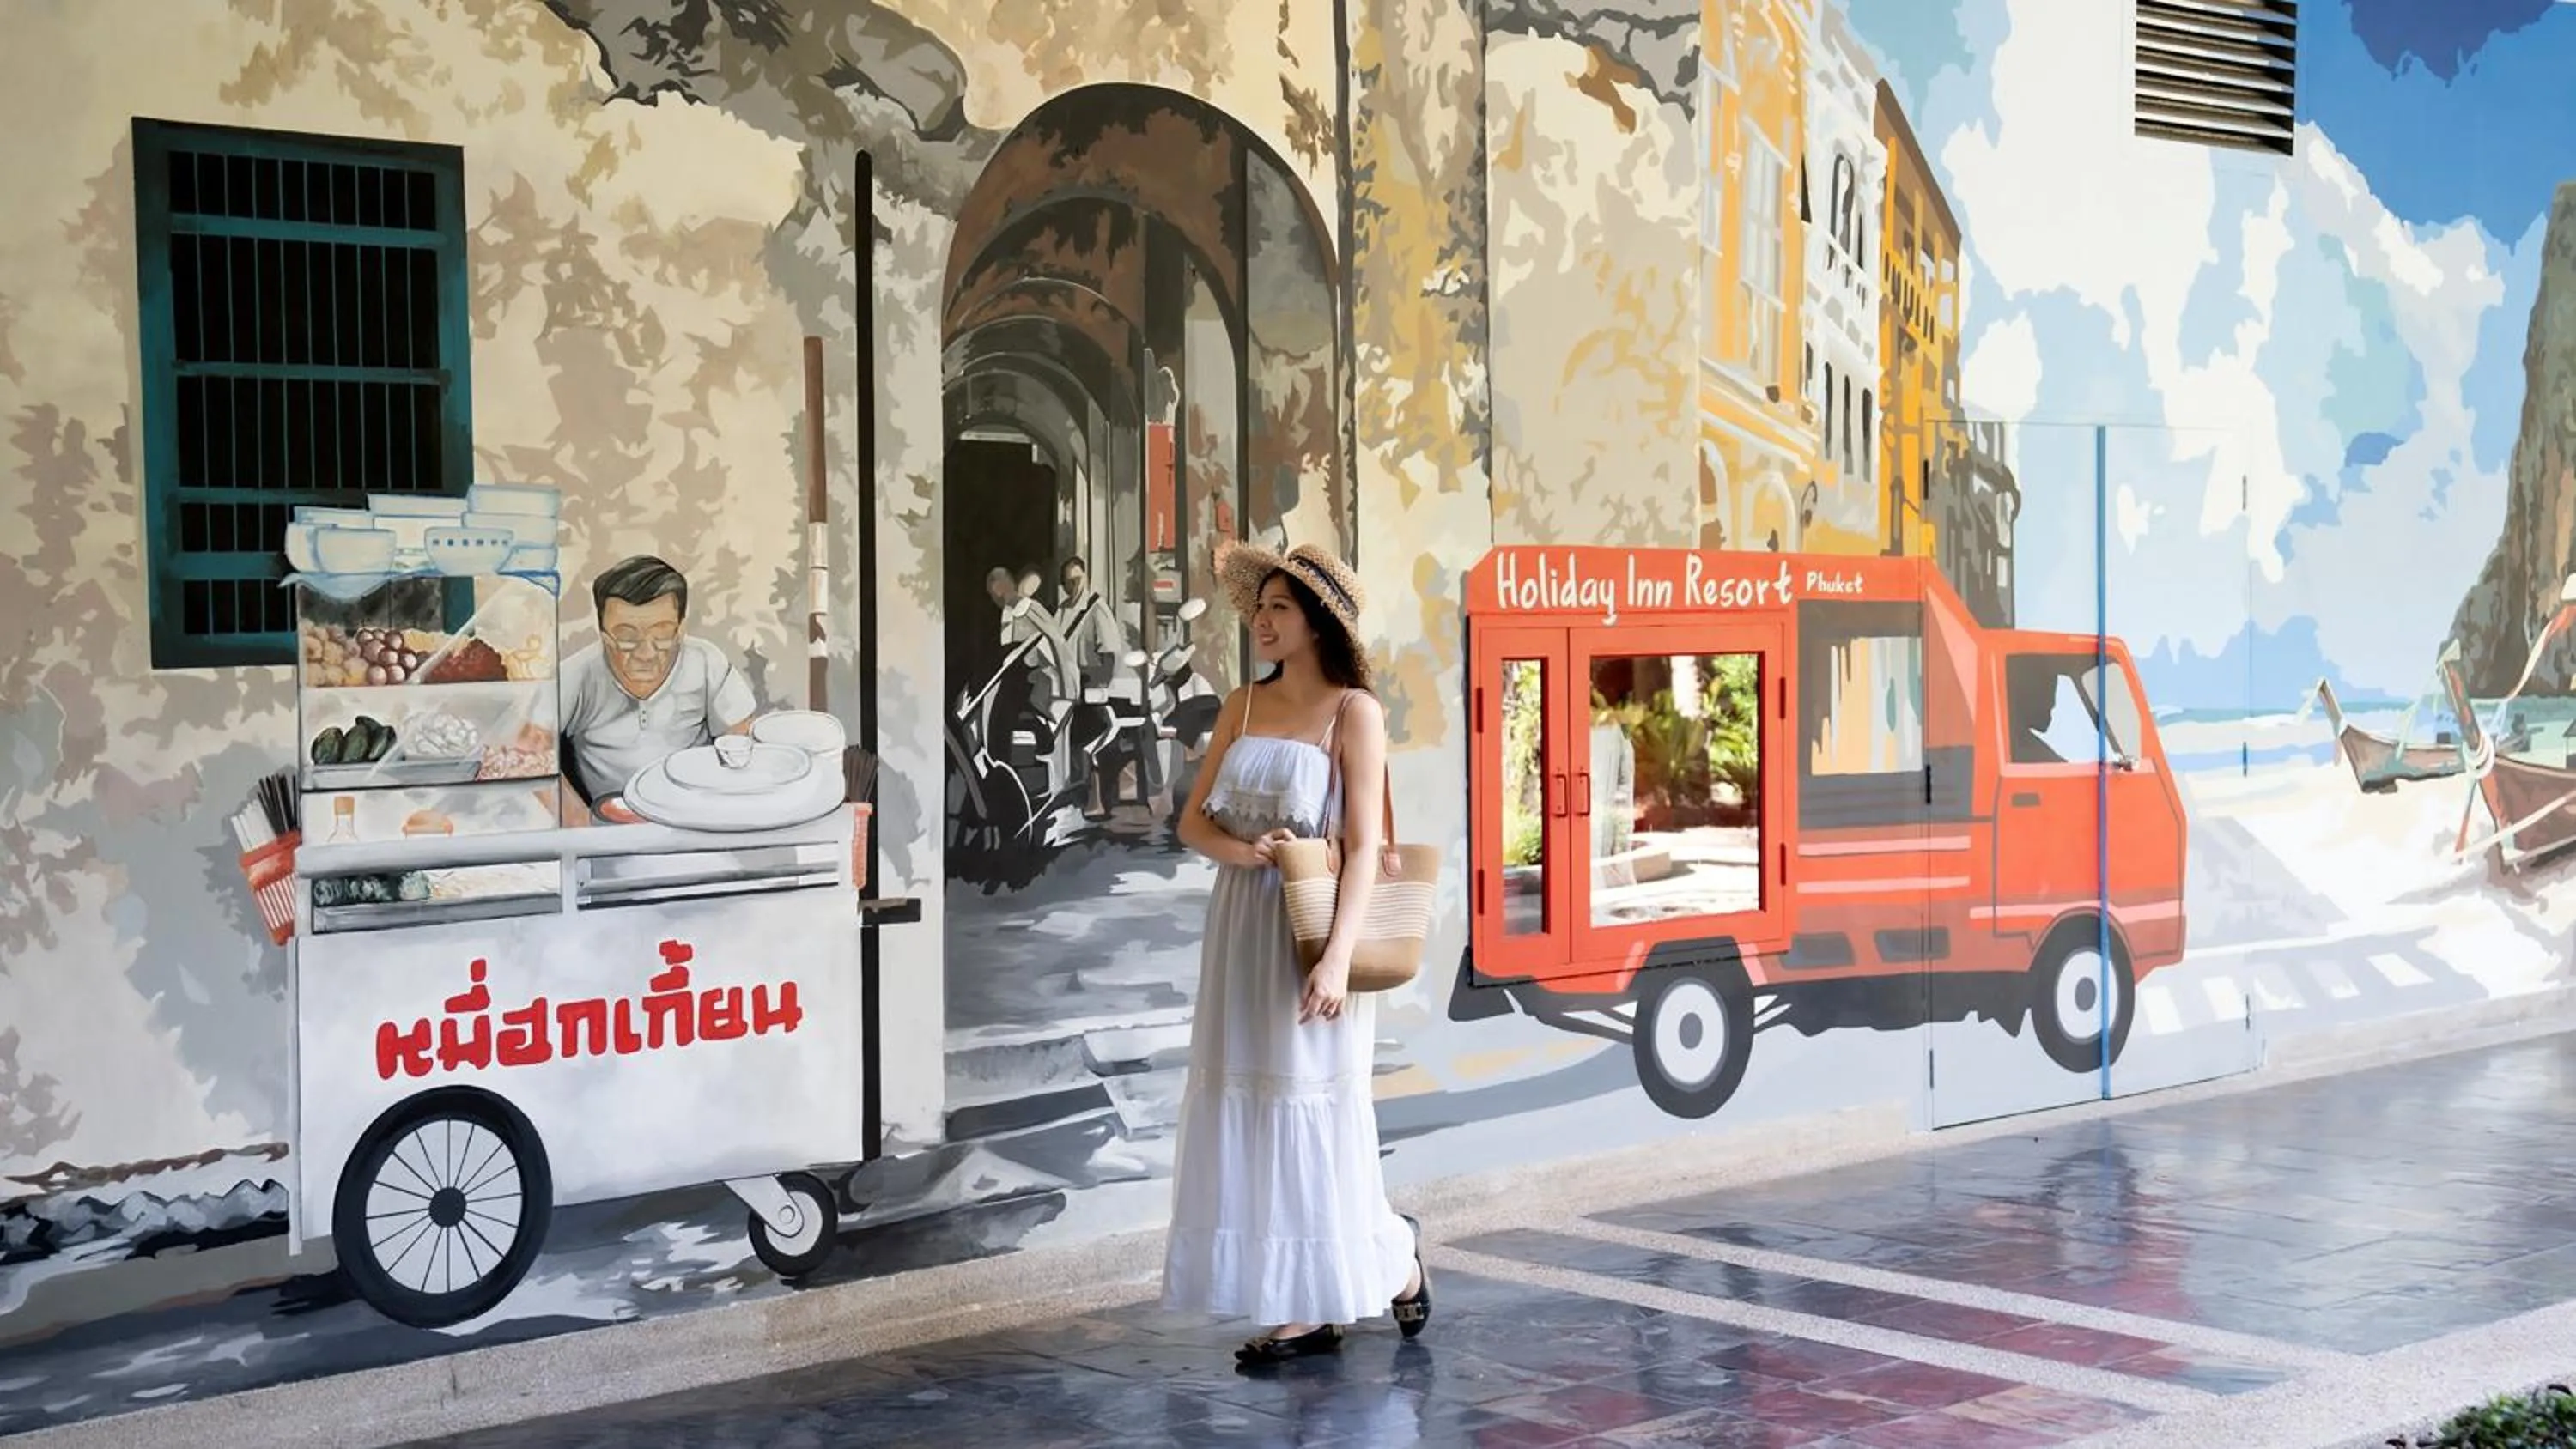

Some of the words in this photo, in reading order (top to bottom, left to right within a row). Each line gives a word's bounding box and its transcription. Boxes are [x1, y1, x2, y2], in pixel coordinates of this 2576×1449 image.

[1496, 551, 1617, 626] Holiday
[1627, 554, 1673, 607] Inn
[1684, 552, 1793, 608] Resort
[1806, 570, 1863, 594] Phuket
